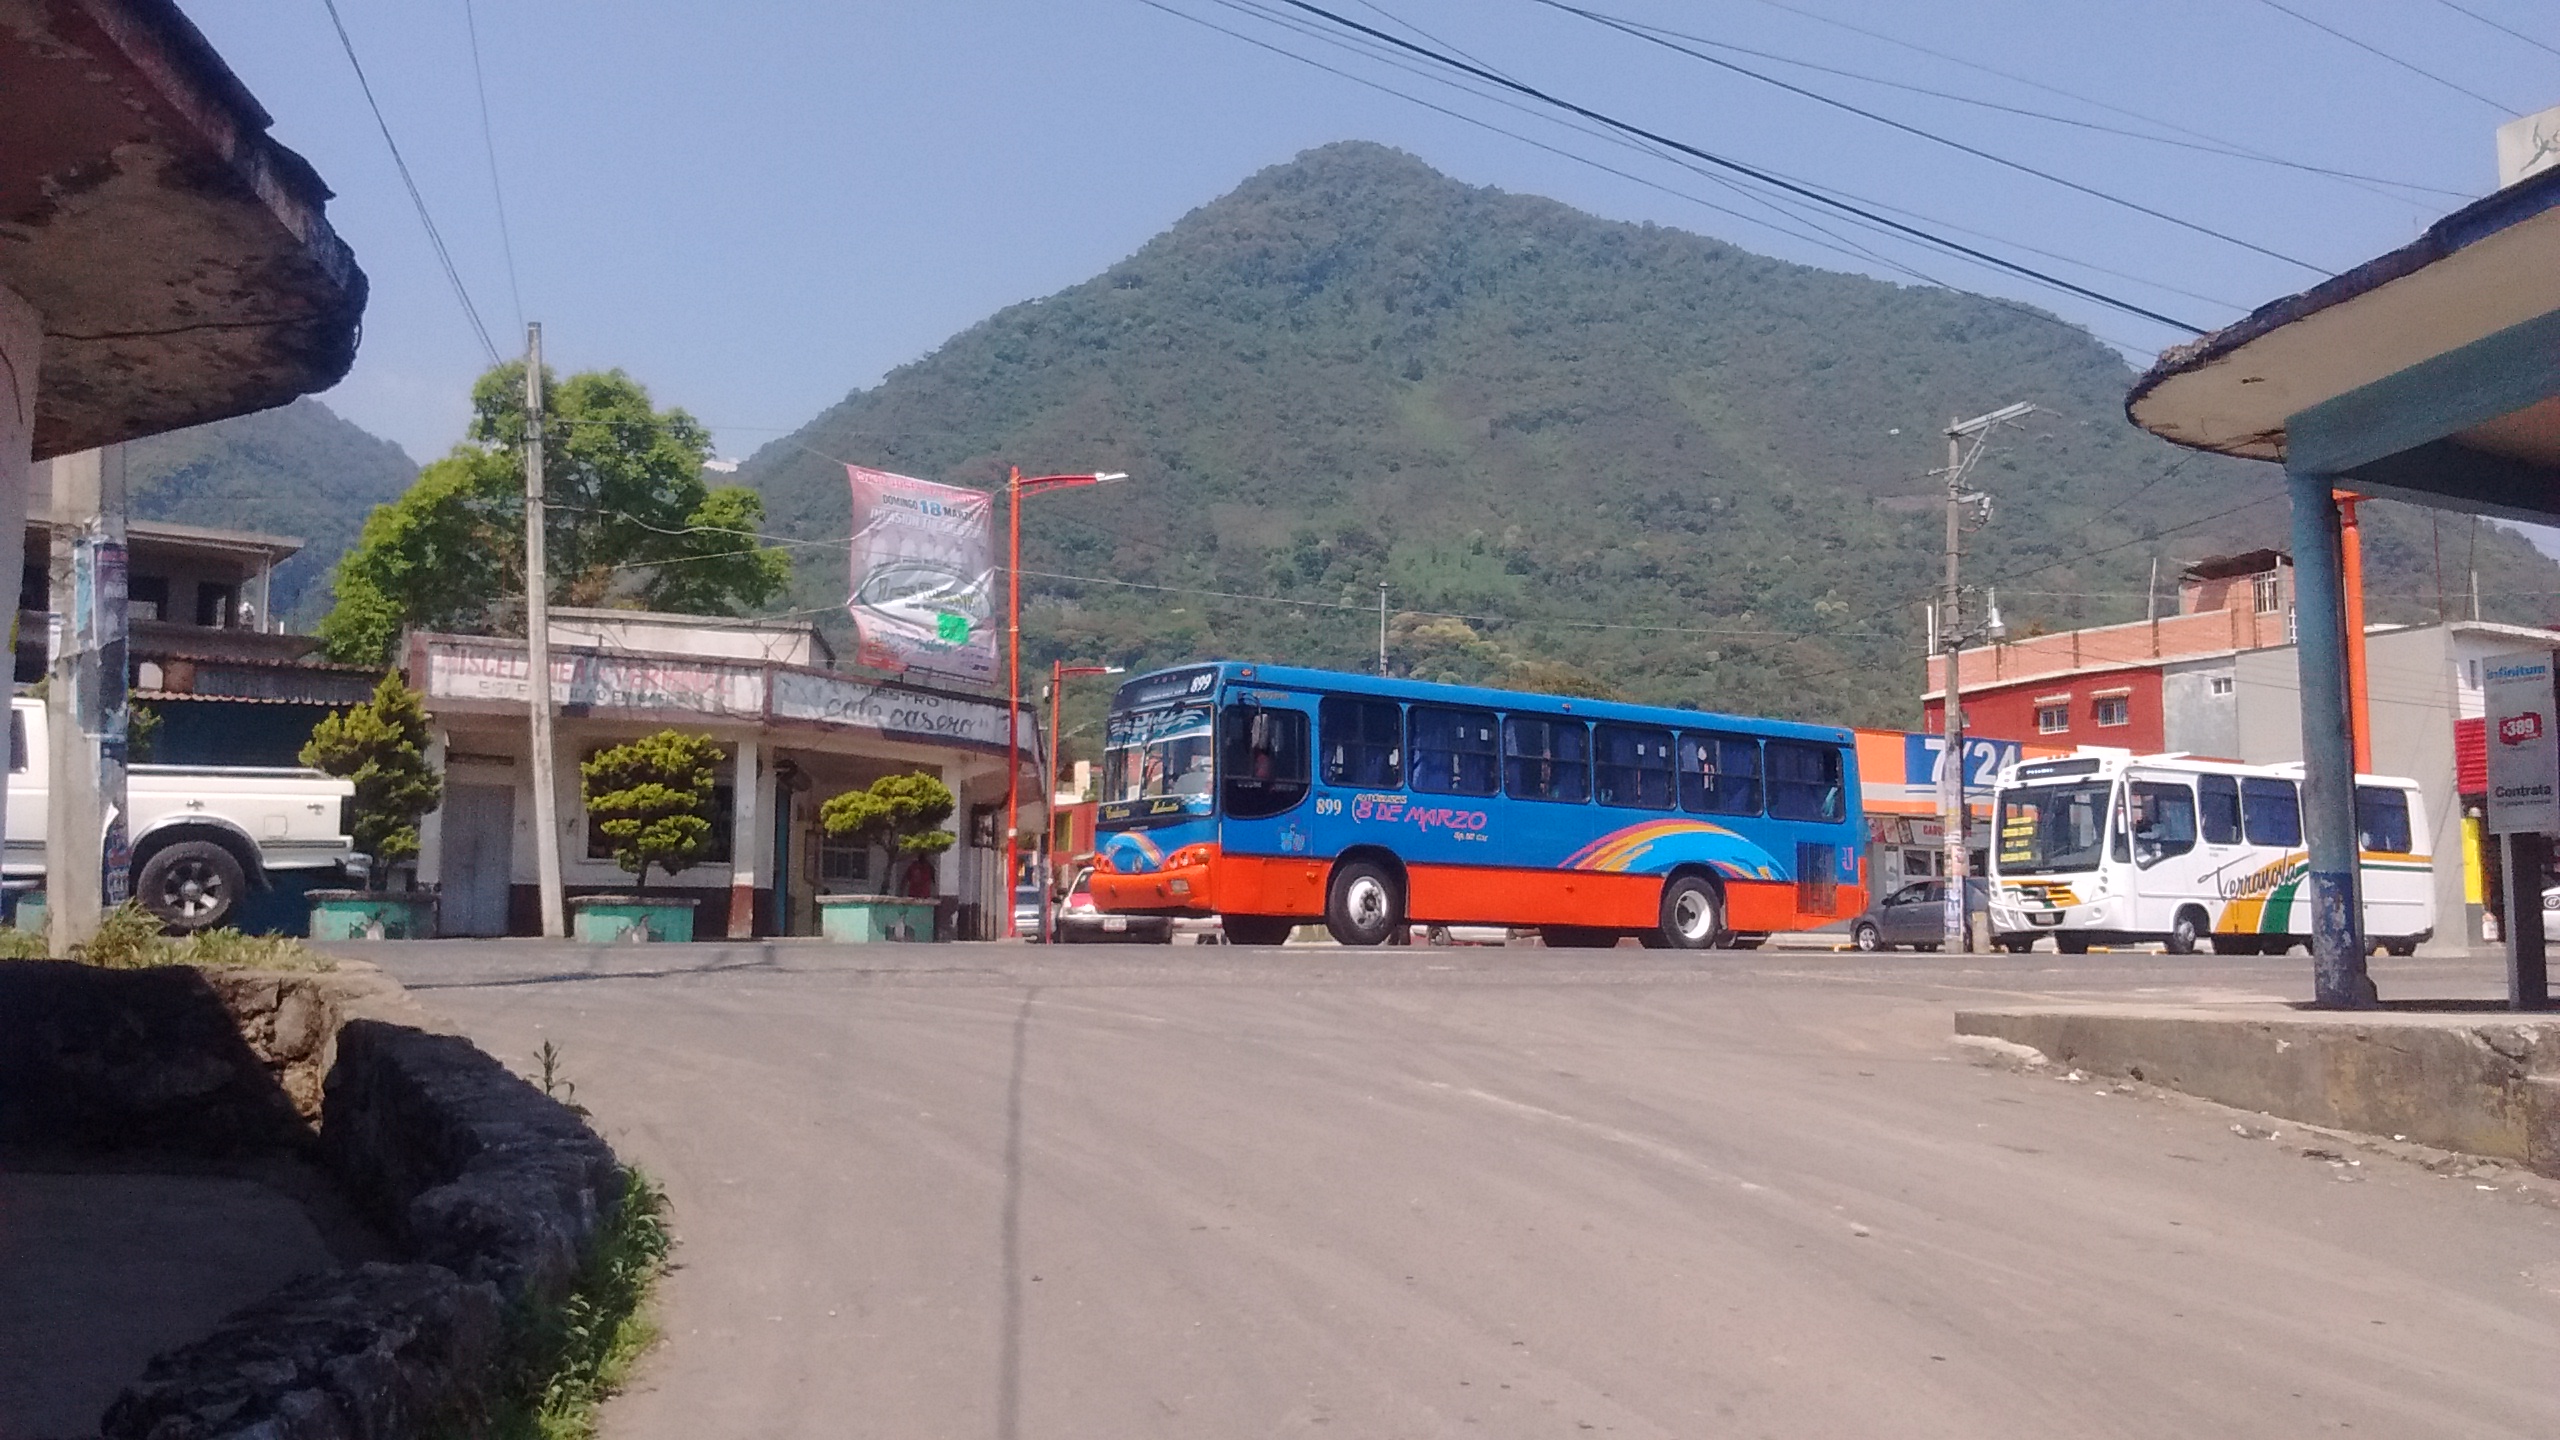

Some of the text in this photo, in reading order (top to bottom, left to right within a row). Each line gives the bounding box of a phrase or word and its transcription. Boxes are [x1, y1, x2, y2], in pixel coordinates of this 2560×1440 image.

[882, 494, 918, 510] DOMINGO
[919, 499, 942, 518] 18
[441, 645, 586, 685] MISCELNEA
[2486, 664, 2546, 681] infinitum
[1190, 673, 1212, 693] 899
[2502, 717, 2535, 737] $389
[2495, 784, 2552, 799] Contrata
[1316, 798, 1342, 816] 899
[1356, 800, 1488, 832] 8 DE MARZO
[2197, 849, 2297, 902] Terranova
